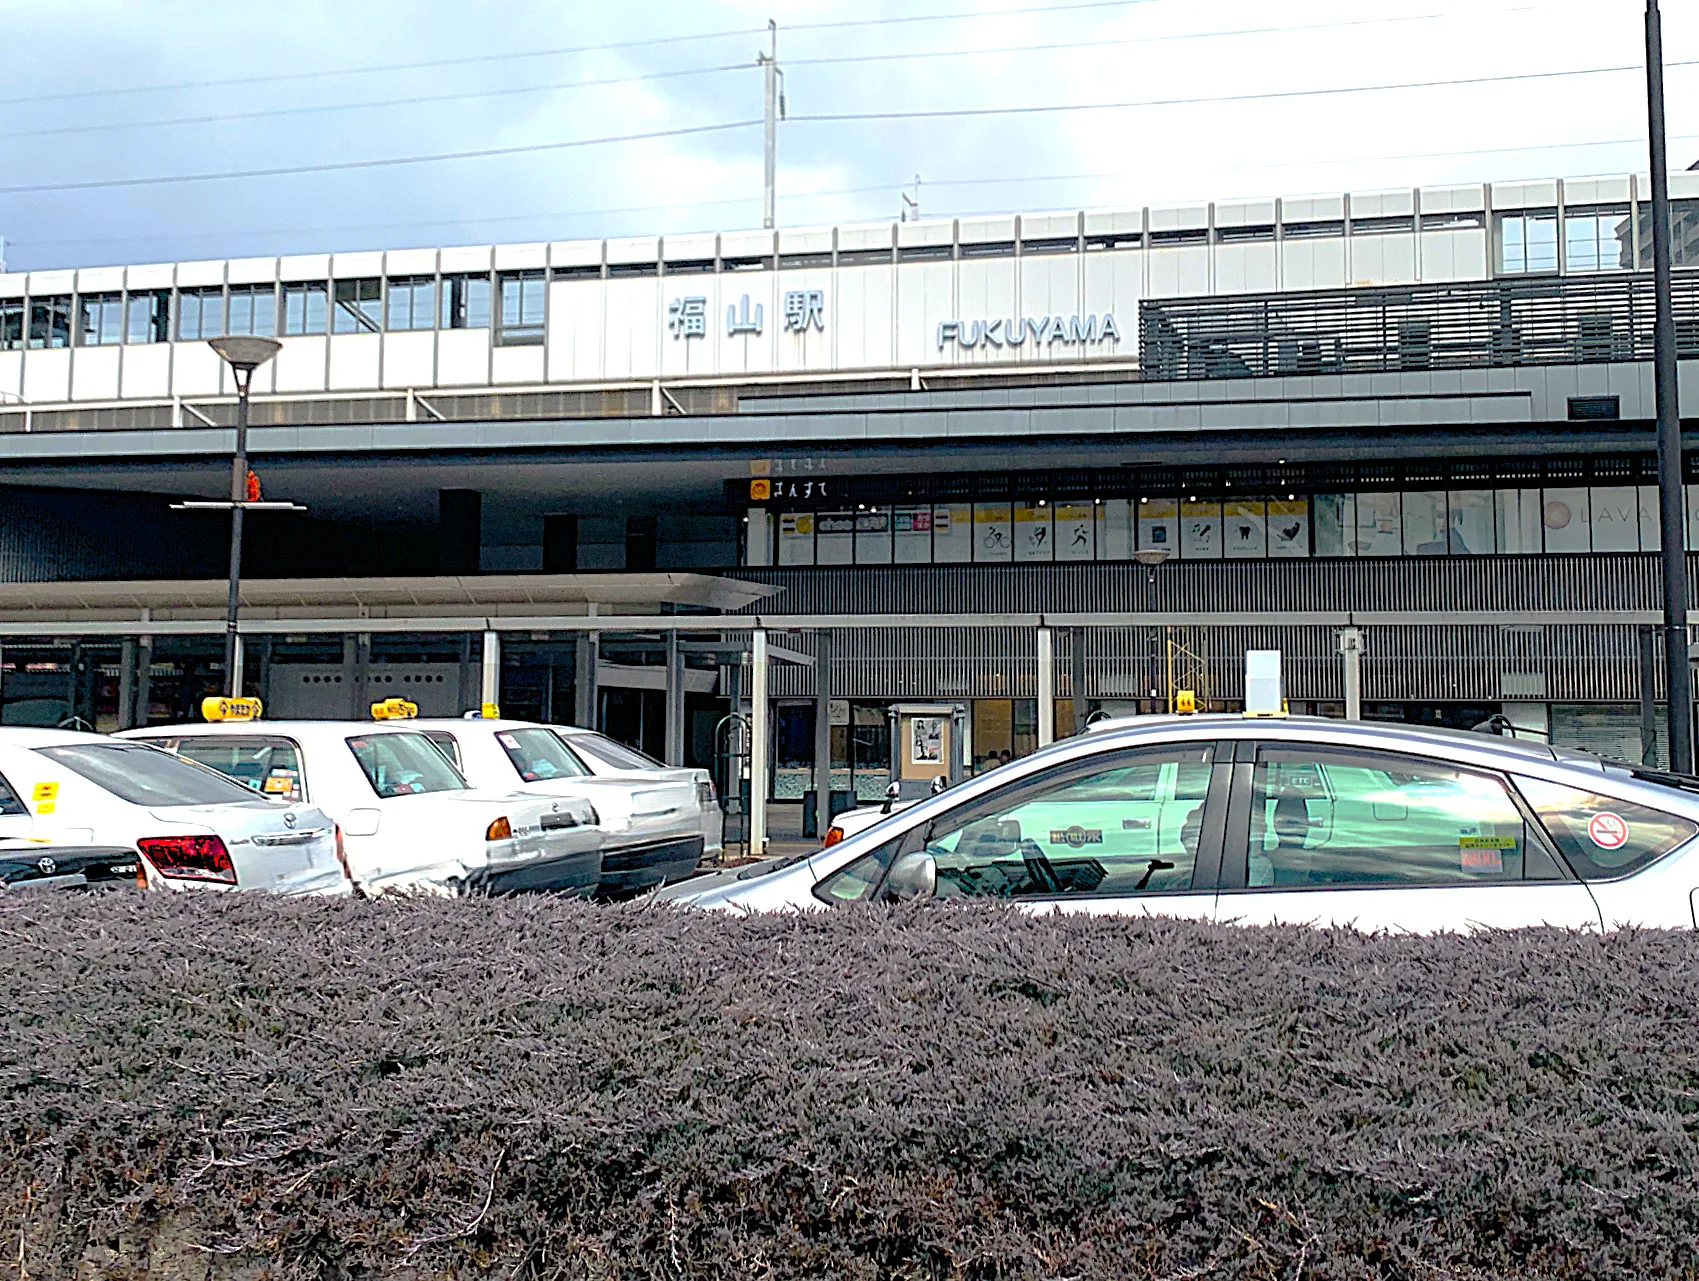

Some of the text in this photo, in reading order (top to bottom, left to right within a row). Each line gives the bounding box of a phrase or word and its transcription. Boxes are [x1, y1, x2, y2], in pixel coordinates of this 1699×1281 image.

[668, 290, 825, 341] 福山駅
[936, 314, 1121, 351] FUKUYAMA
[1580, 507, 1652, 523] LAVA
